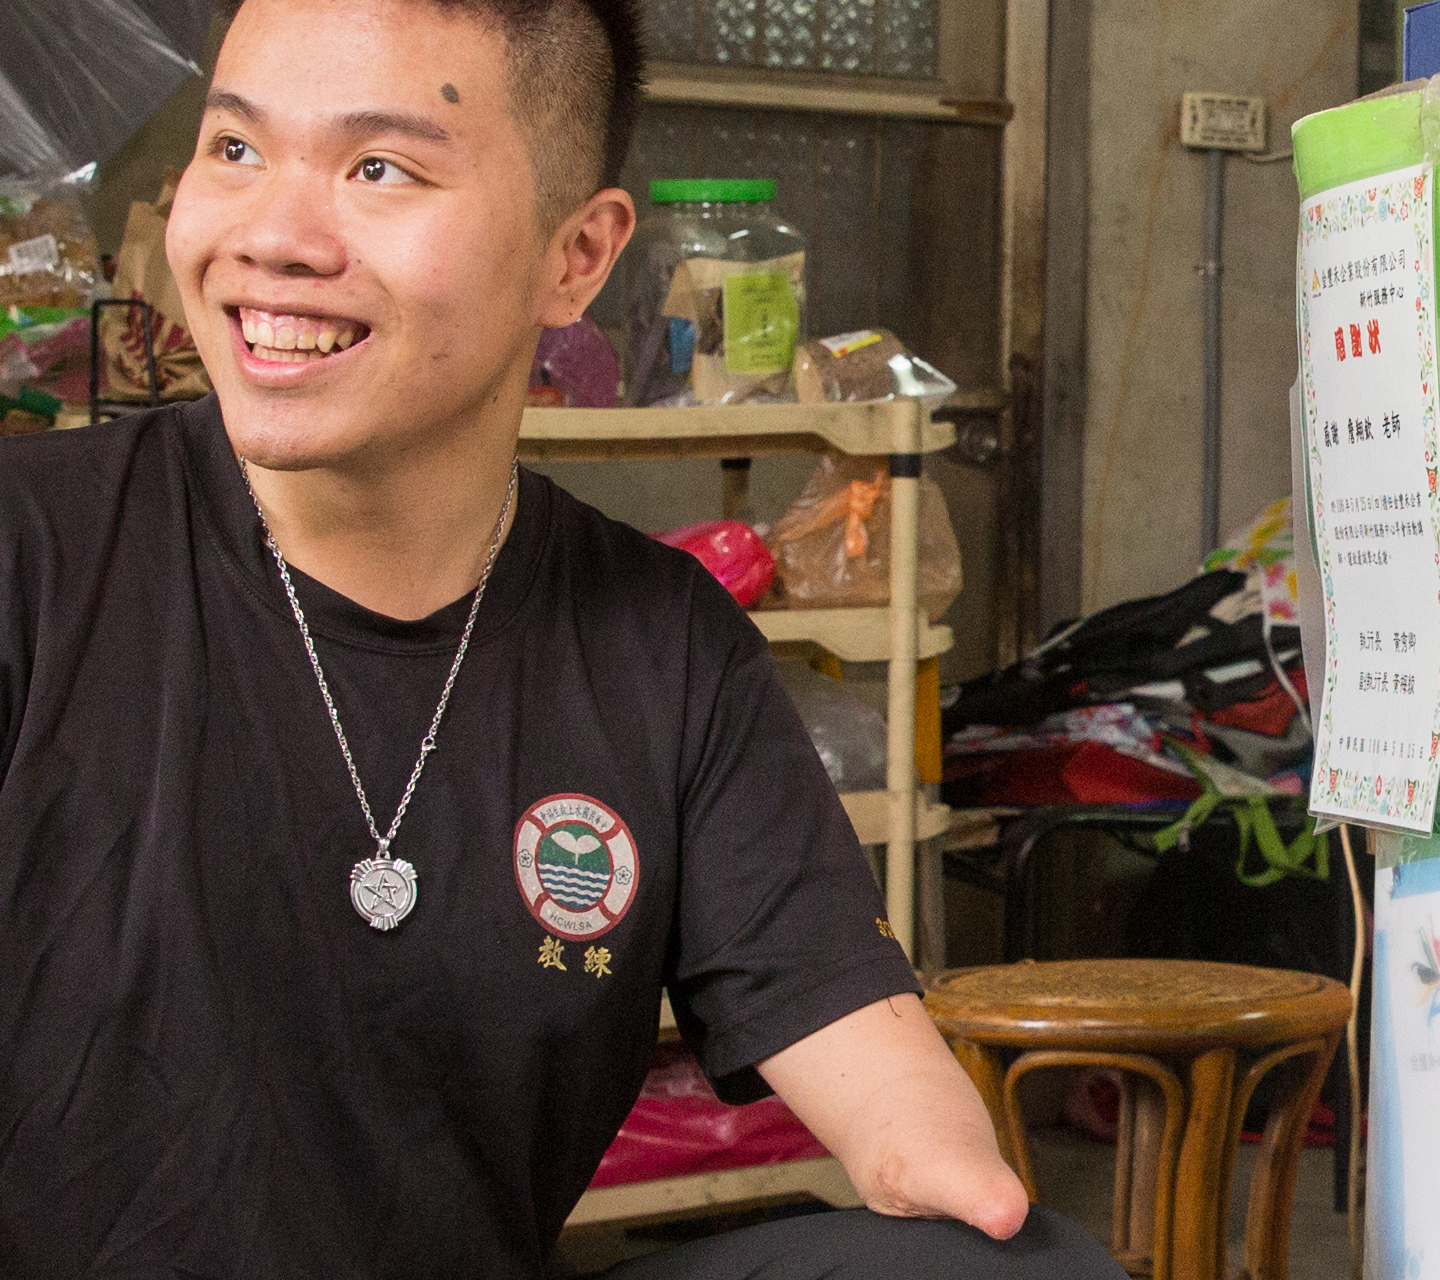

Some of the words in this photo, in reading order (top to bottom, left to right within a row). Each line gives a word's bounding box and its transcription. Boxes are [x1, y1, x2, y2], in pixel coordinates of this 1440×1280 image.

[1382, 412, 1401, 439] 老師
[549, 913, 593, 931] HCWLSA
[538, 935, 612, 979] 教練
